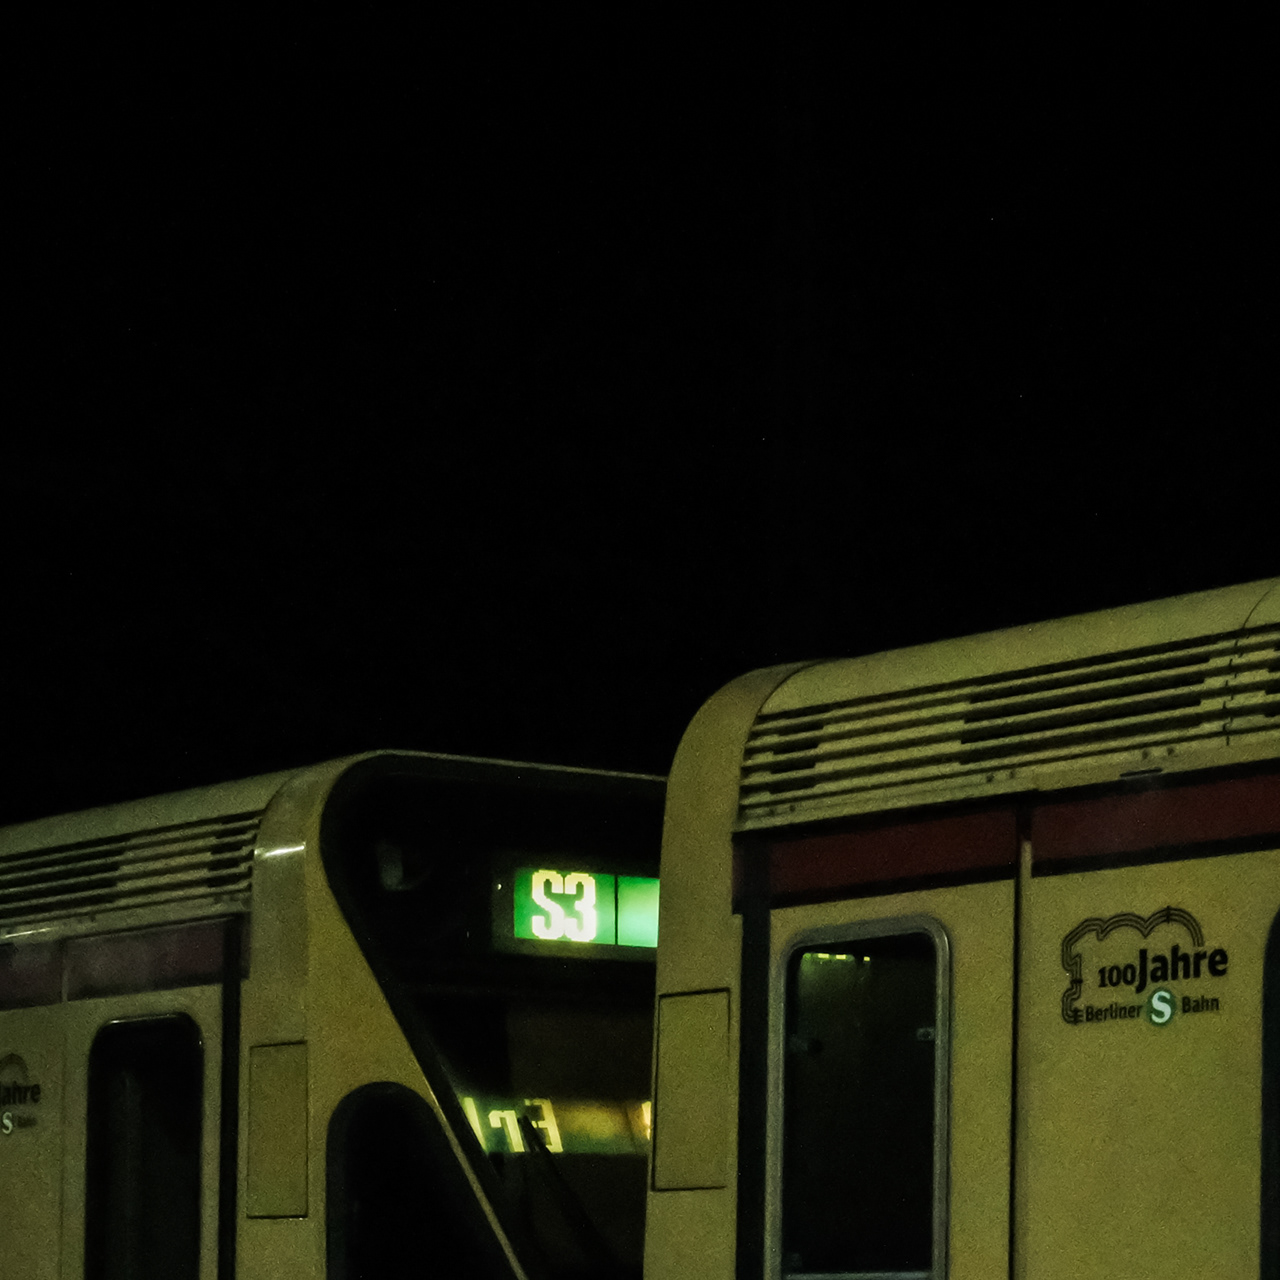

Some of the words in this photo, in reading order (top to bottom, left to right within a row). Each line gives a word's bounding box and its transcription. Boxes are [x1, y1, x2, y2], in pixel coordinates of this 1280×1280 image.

[532, 869, 596, 942] S3
[1085, 1002, 1144, 1022] Berliner
[1181, 995, 1220, 1014] Bahn
